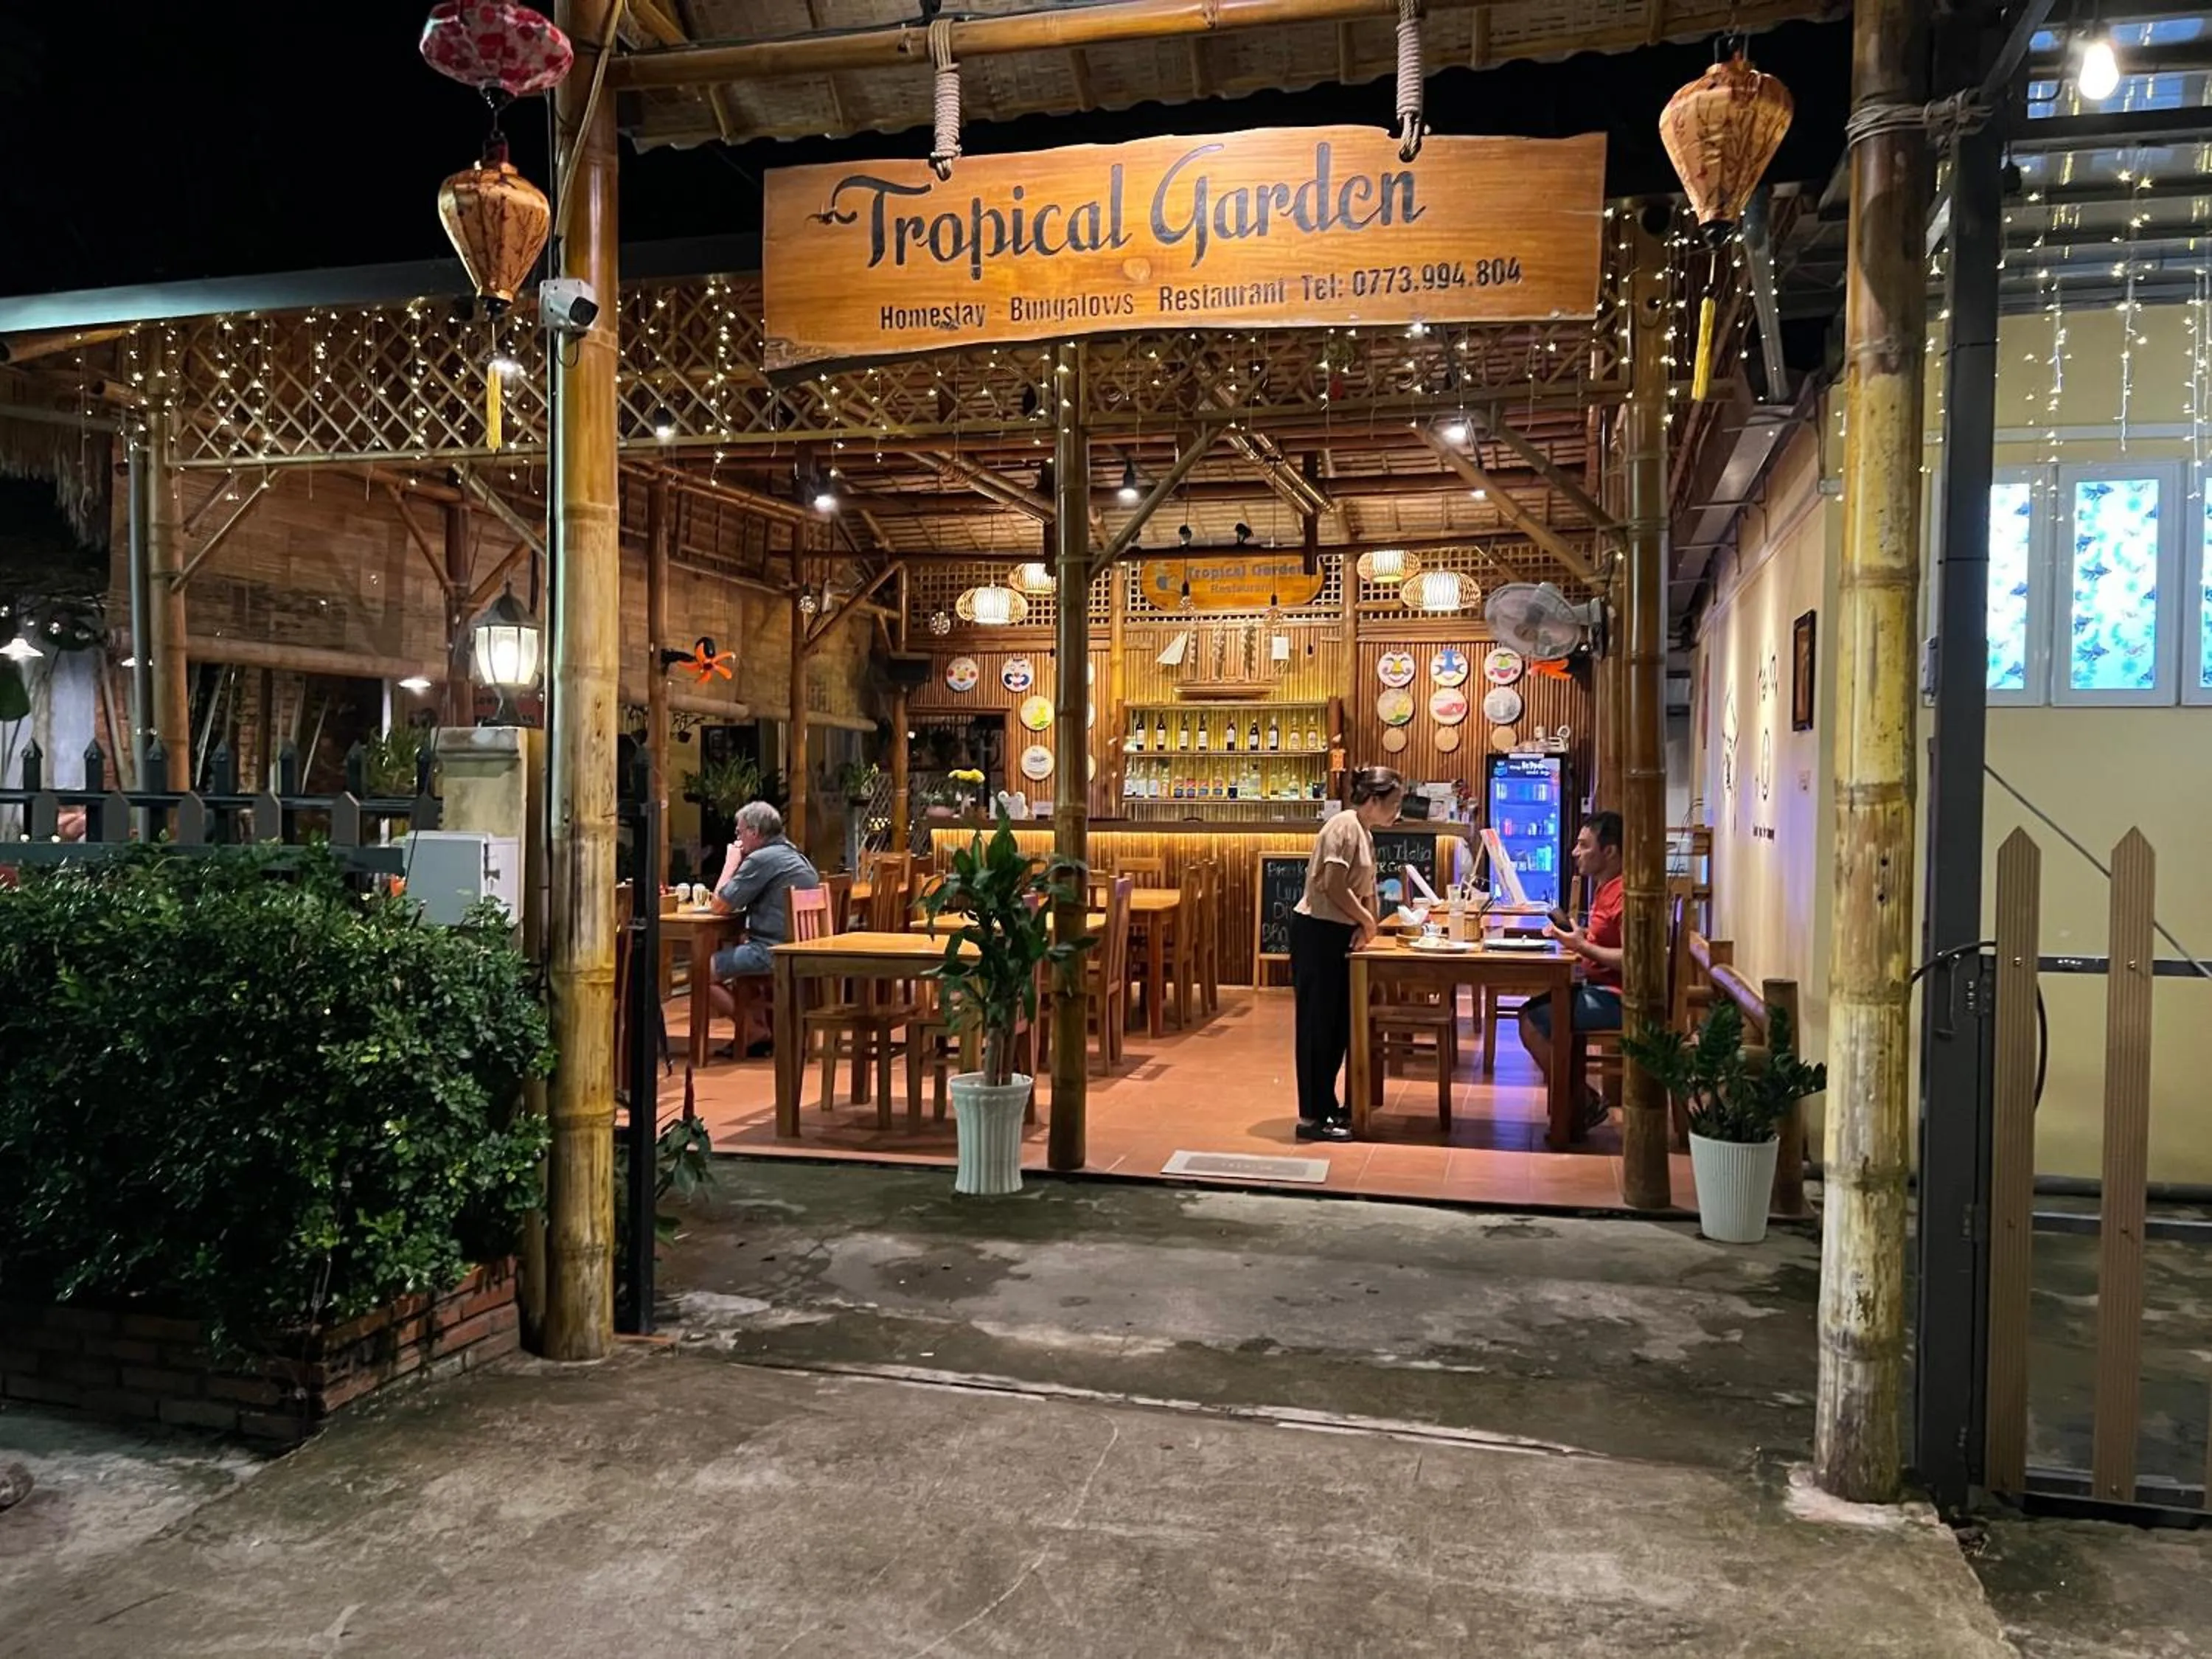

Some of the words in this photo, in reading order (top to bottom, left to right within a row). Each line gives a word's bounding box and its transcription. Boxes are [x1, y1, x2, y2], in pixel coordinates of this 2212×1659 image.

[830, 163, 1133, 281] Tropical
[1150, 142, 1426, 268] Garden
[880, 302, 986, 330] Homestay
[1010, 292, 1133, 322] Bungalows
[1158, 277, 1286, 312] Restaurant
[1301, 274, 1343, 301] Tel:
[1352, 257, 1522, 296] 0773.994.804
